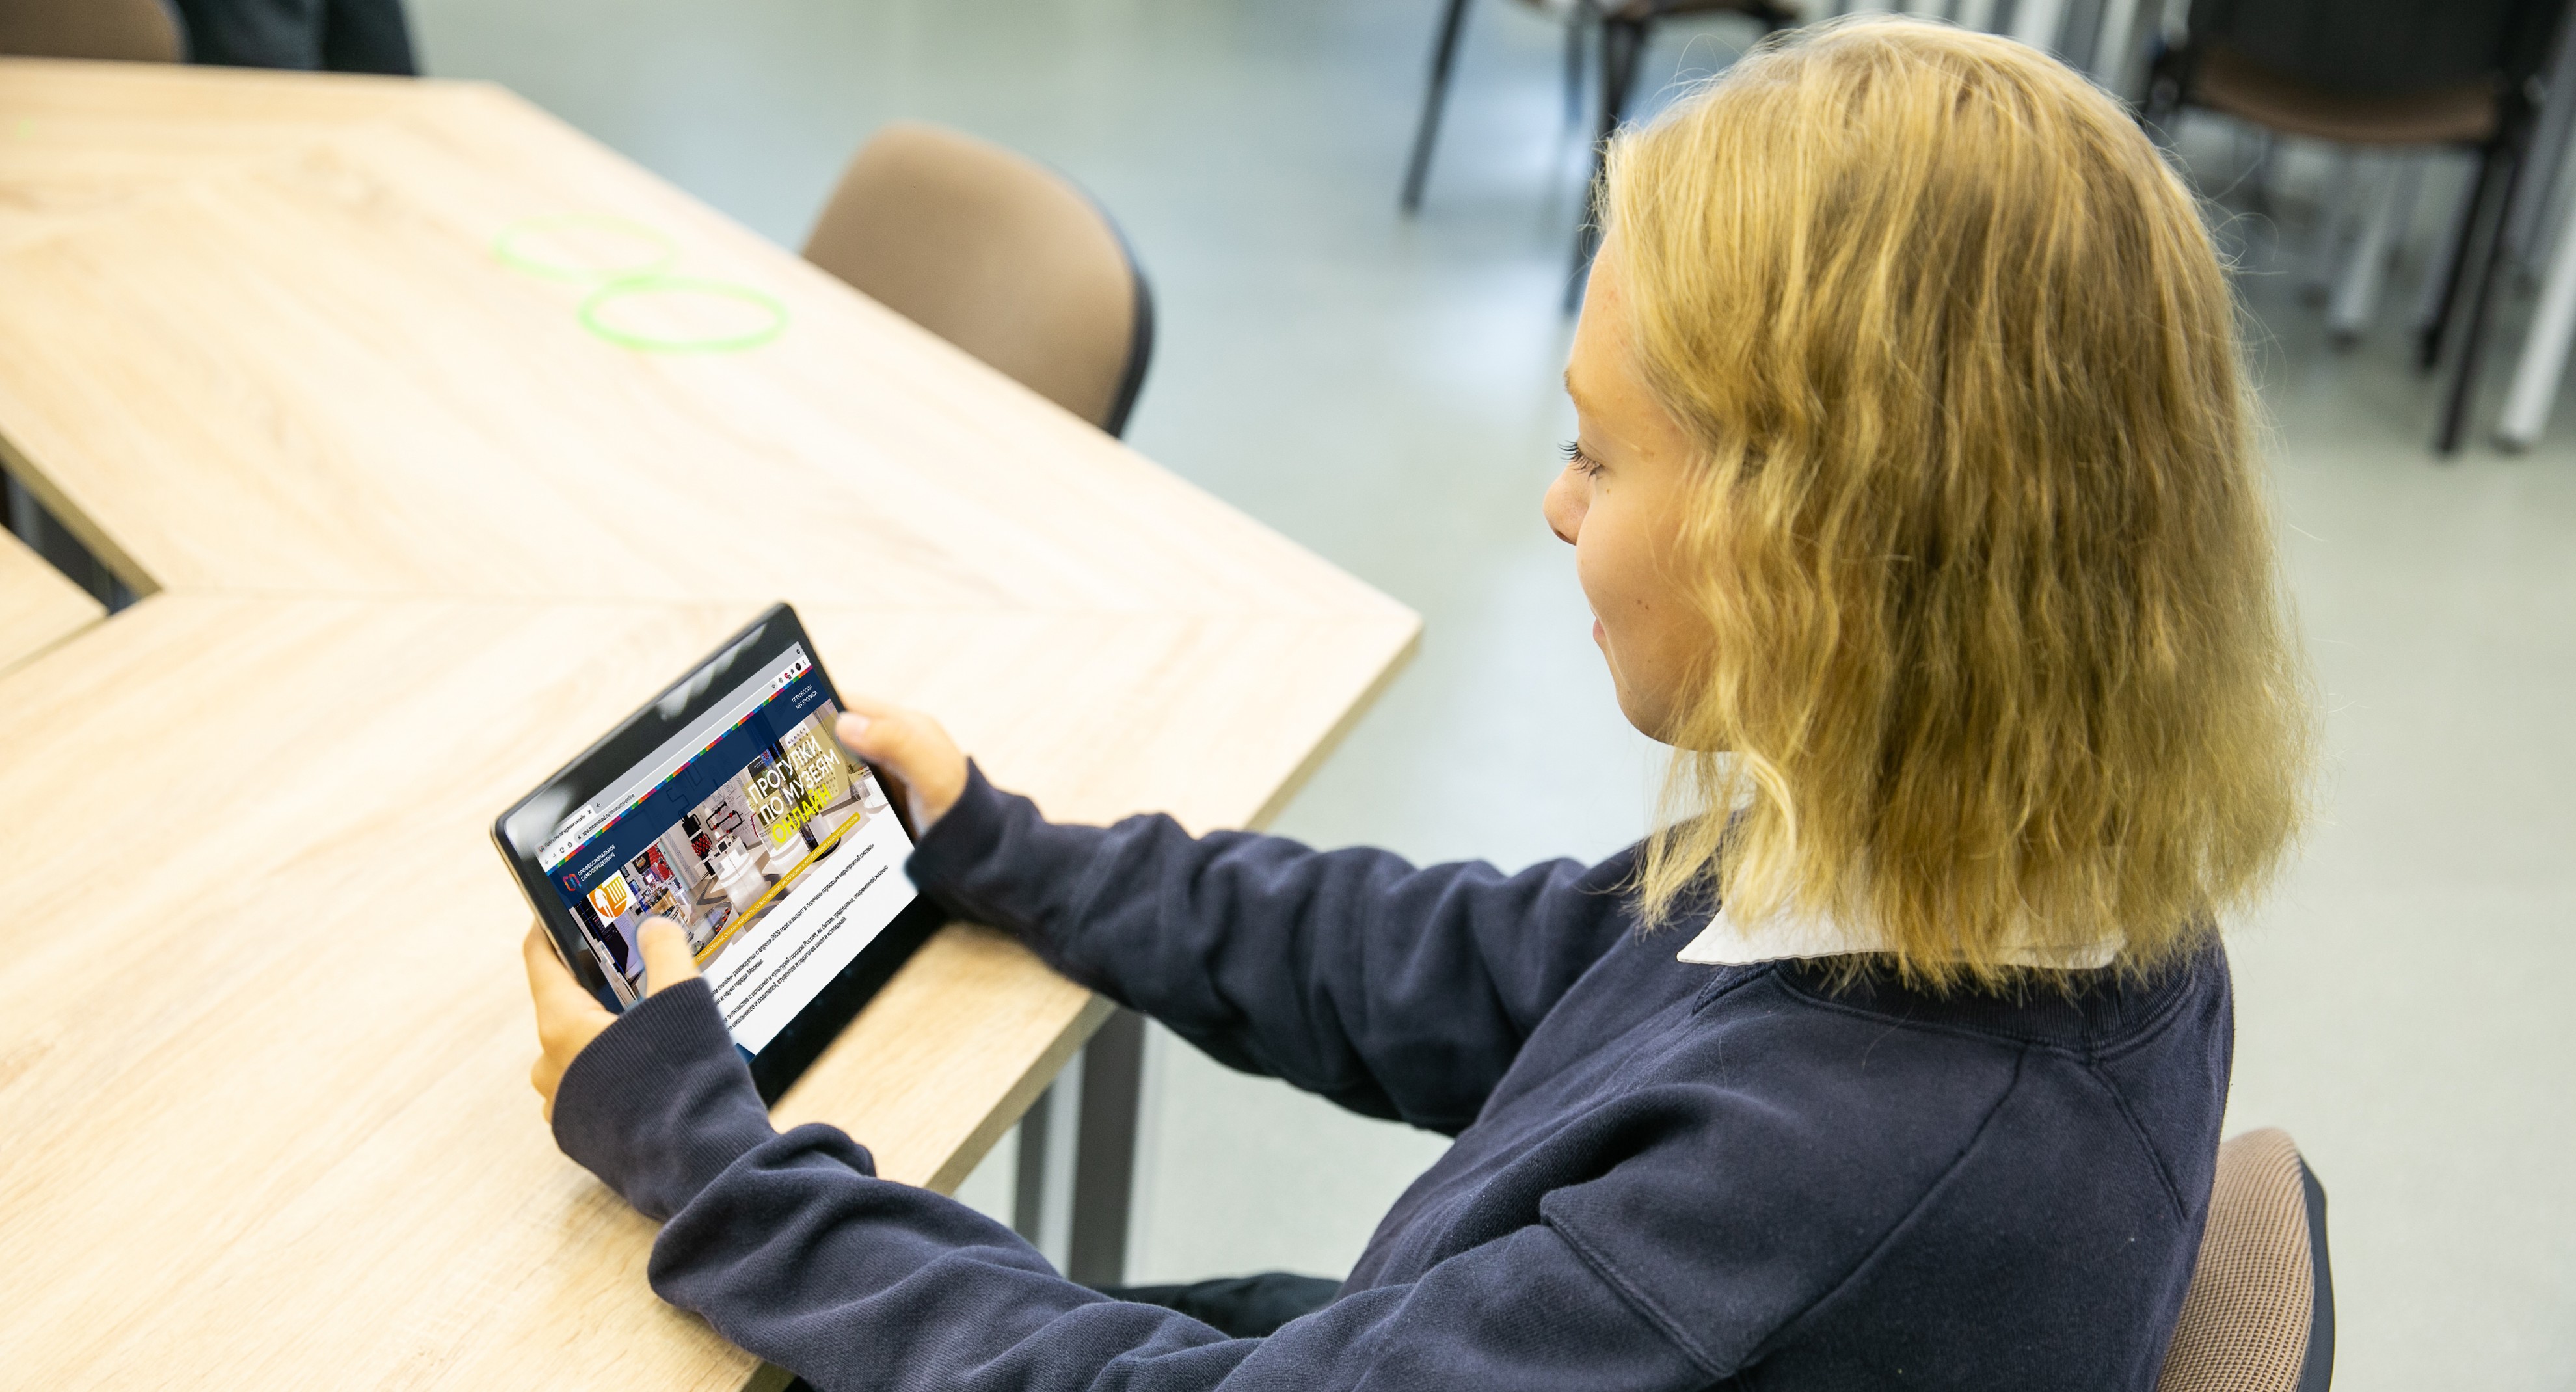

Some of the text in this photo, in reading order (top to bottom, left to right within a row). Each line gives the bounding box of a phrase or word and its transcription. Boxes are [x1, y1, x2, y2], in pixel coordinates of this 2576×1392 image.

[791, 684, 812, 703] ПРОФЕССИИ
[795, 690, 818, 710] МЕГАПОЛИСА
[748, 735, 820, 805] ПРОГУЛКИ
[759, 796, 785, 825] ПО
[783, 747, 840, 805] МУЗЕЯМ
[771, 784, 832, 843] ОНЛАЙН
[577, 844, 615, 876] ПРОФЕССИОНАЛЬНОЕ
[580, 851, 615, 881] САМООПРЕДЕЛЕНИЕ
